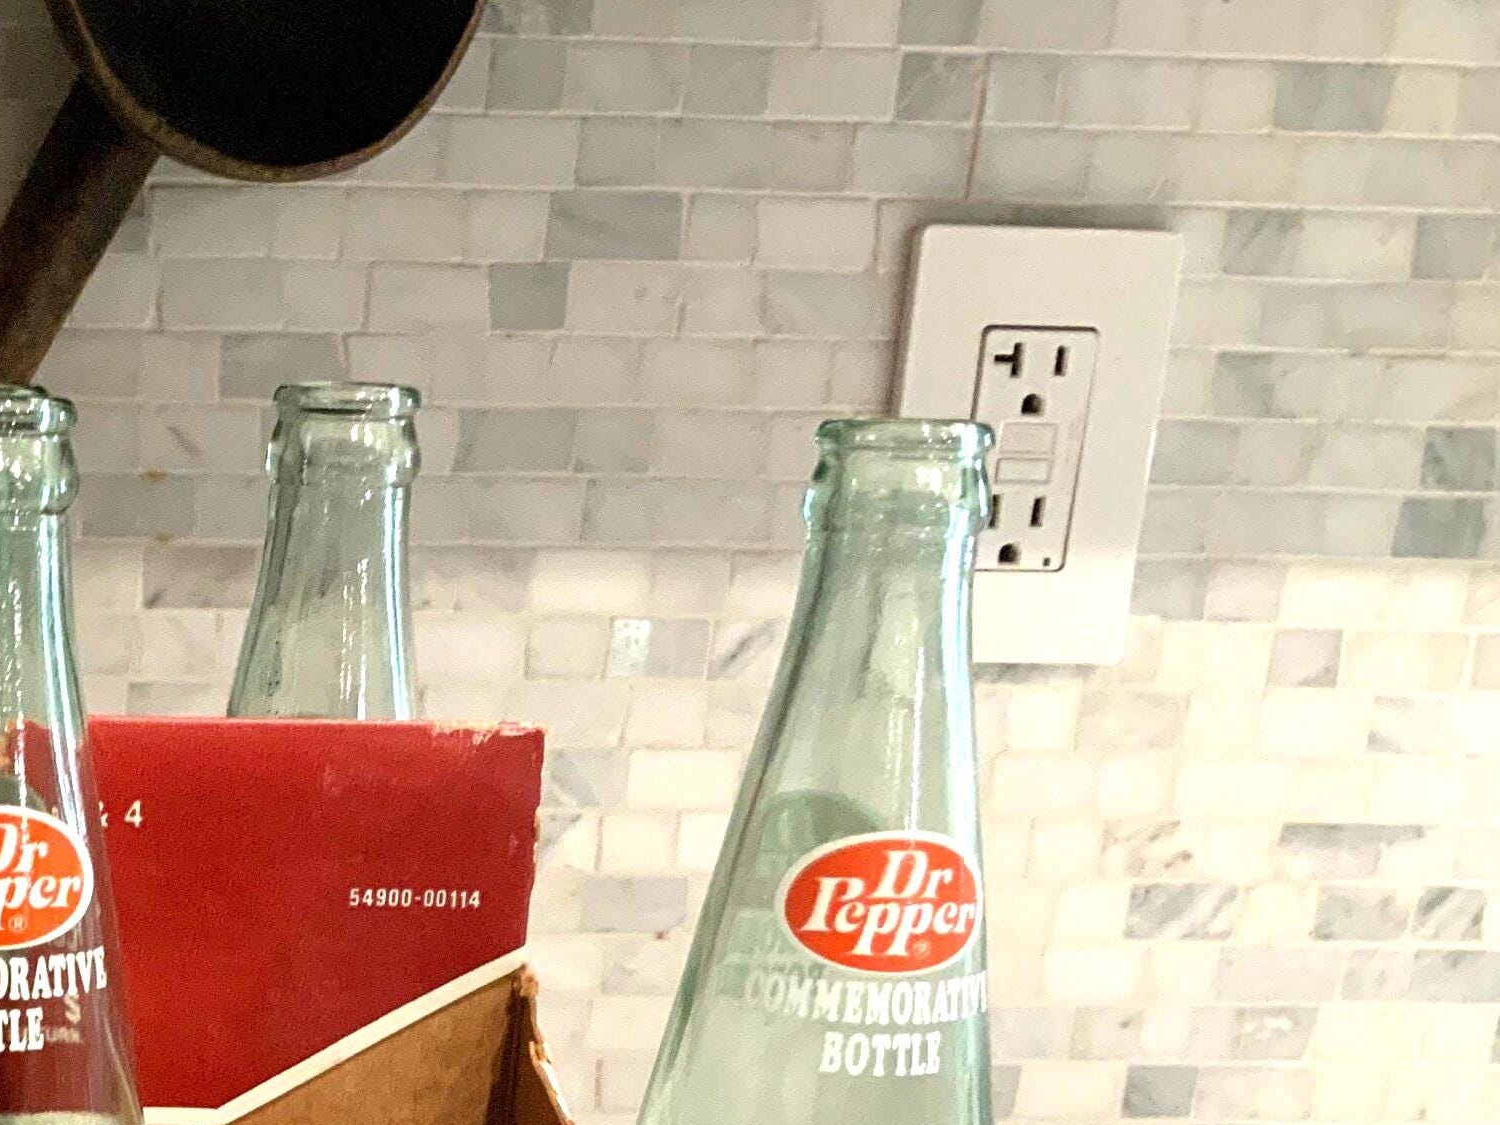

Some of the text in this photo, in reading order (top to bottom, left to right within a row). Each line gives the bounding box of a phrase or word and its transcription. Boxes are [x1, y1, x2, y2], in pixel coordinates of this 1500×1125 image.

[123, 800, 144, 828] 4
[348, 887, 482, 909] 54900-00114
[867, 850, 954, 900] Dr
[799, 876, 976, 957] Pepper
[819, 1030, 942, 1077] BOTTLE
